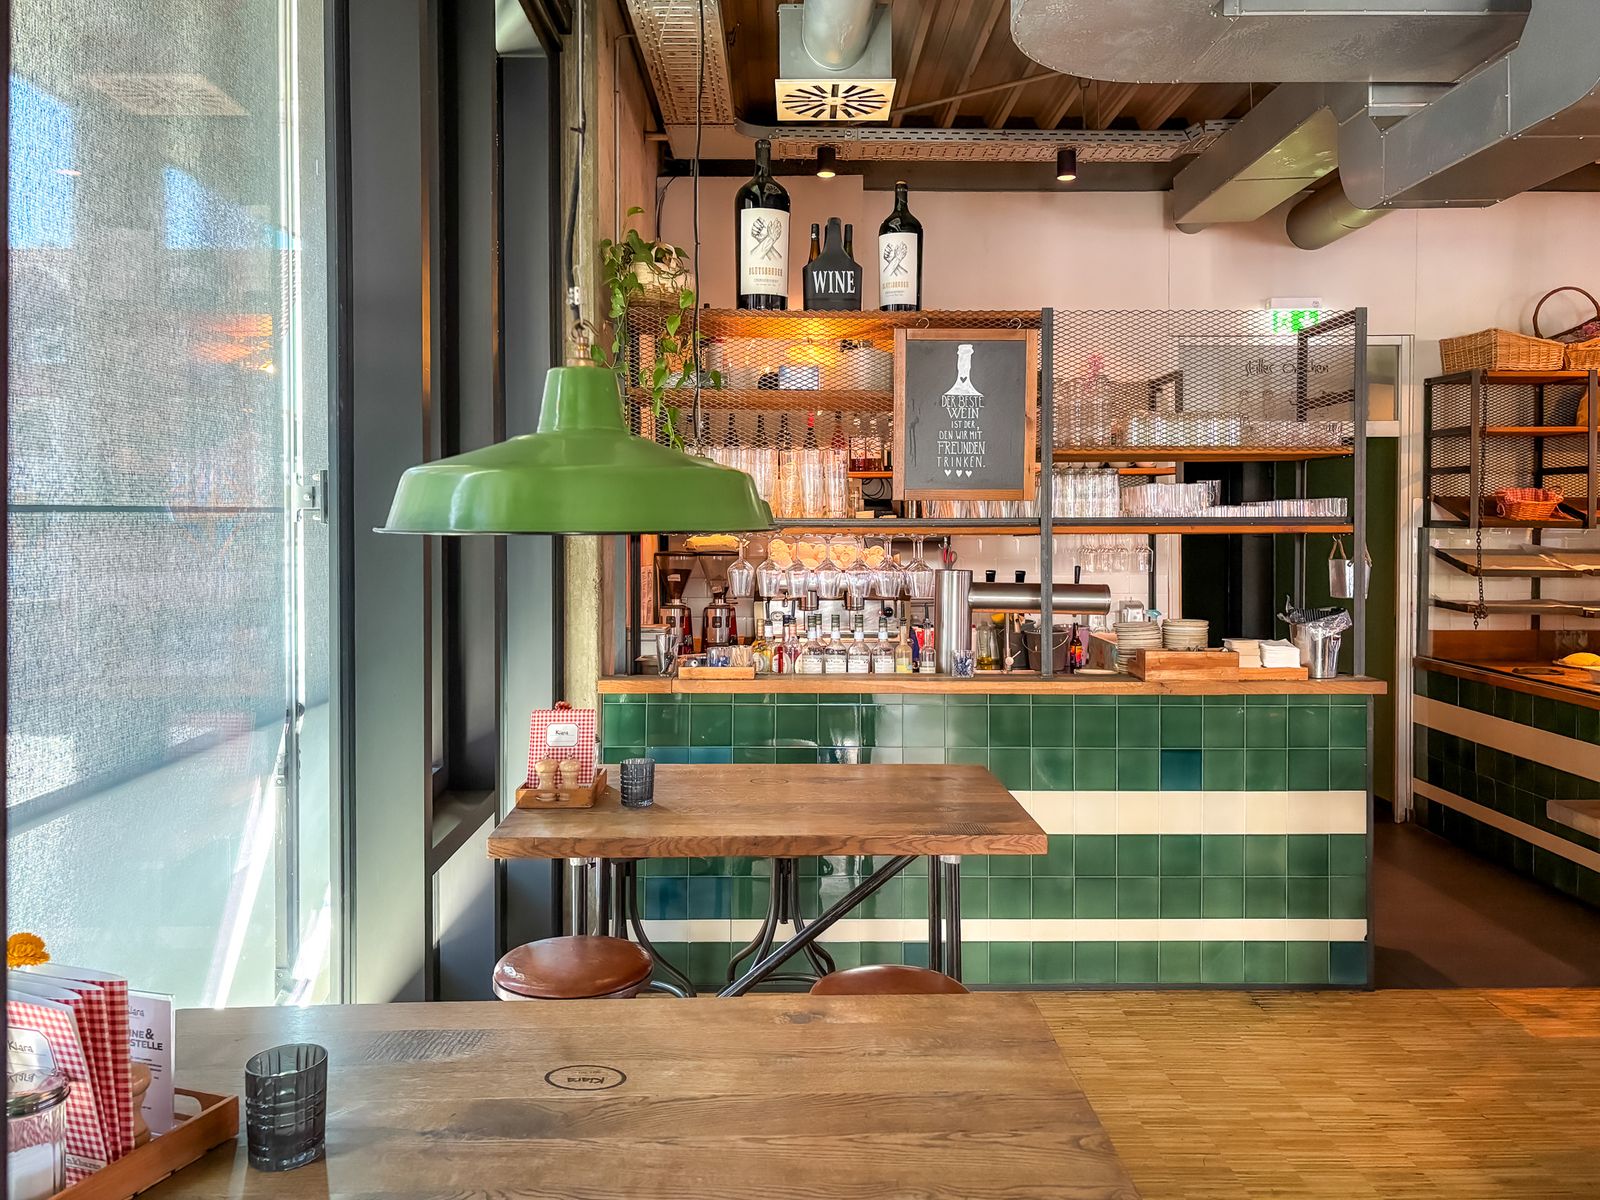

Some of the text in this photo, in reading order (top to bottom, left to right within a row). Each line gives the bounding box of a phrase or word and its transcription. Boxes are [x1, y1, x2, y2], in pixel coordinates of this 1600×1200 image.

[812, 270, 856, 294] WINE
[941, 394, 985, 408] DER BESTE
[947, 407, 979, 418] WEIN
[951, 420, 963, 429] IST
[939, 430, 983, 440] DEN WIR MIT
[937, 441, 986, 455] FREUNDEN
[128, 1005, 145, 1017] lara
[7, 1040, 34, 1053] Klara
[129, 1038, 164, 1051] STELLE
